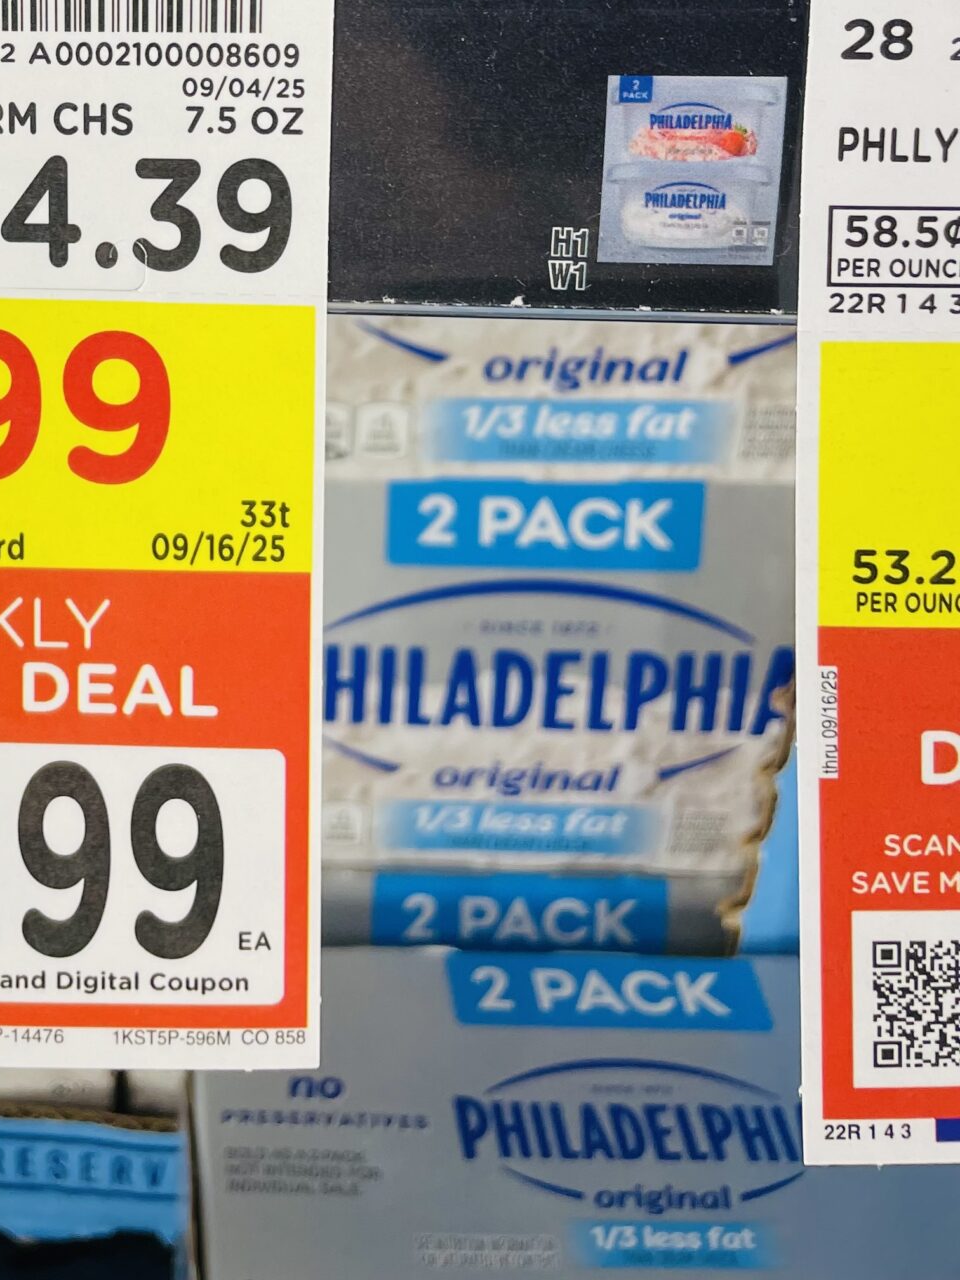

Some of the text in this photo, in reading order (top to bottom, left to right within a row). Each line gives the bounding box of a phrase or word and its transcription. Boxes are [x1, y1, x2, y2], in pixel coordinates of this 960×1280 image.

[29, 42, 300, 67] A0002100008609
[841, 19, 913, 60] 28
[182, 76, 305, 101] 09/04/25
[53, 102, 134, 136] CHS
[186, 106, 304, 135] 7.5 OZ
[649, 113, 732, 131] PHILADELPHIA
[838, 127, 959, 163] PHLLY
[1, 155, 292, 273] 4.39
[644, 191, 726, 210] PHILADELPHIA
[550, 226, 588, 257] H1
[548, 260, 587, 291] W1
[837, 258, 960, 278] PER OUNC
[828, 293, 937, 314] 22R 4
[482, 348, 691, 391] original
[460, 405, 698, 440] 1/3 less fat
[240, 502, 290, 529] 33t
[416, 494, 675, 552] 2 PACK
[152, 533, 286, 565] 09/16/25
[856, 592, 897, 612] PER
[22, 660, 219, 718] DEAL
[822, 670, 838, 774] thru 09/16/25
[433, 763, 624, 796] original
[476, 806, 630, 835] less fat
[852, 871, 930, 894] SAVE
[401, 892, 639, 946] 2 PACK
[239, 931, 271, 951] EA
[0, 970, 45, 989] and
[56, 972, 140, 993] Digital
[149, 973, 249, 995] Coupon
[470, 966, 733, 1018] 2 PACK
[113, 1030, 231, 1046] 1KST5P-596M
[241, 1030, 269, 1046] CO
[275, 1031, 306, 1046] 858
[288, 1076, 345, 1099] no
[452, 1094, 802, 1163] PHILADELPHI
[824, 1124, 861, 1140] 22R
[593, 1183, 732, 1214] original
[590, 1225, 758, 1251] 1/3 less fat
